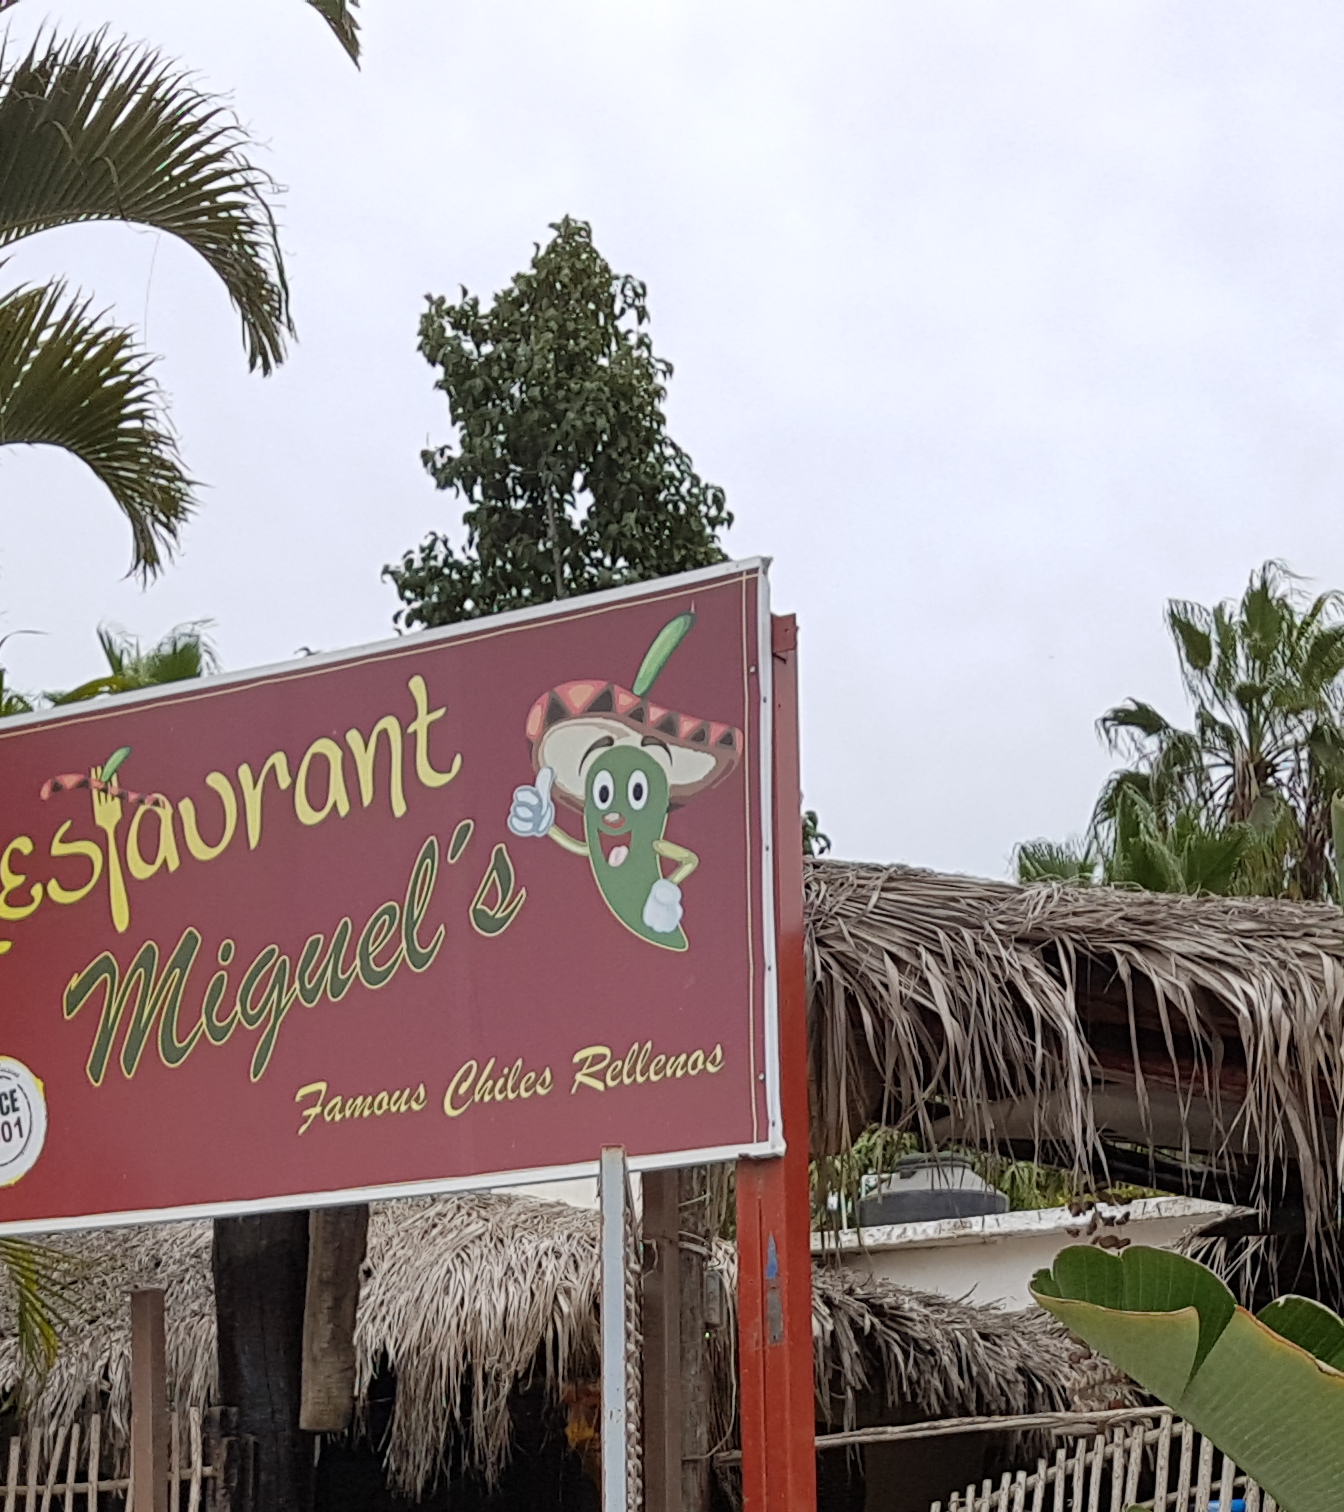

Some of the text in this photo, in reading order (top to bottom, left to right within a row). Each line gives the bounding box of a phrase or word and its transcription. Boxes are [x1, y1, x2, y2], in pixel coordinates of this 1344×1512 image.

[63, 819, 527, 1087] Miguel's
[294, 1039, 726, 1136] Famous Chiles Rellenos
